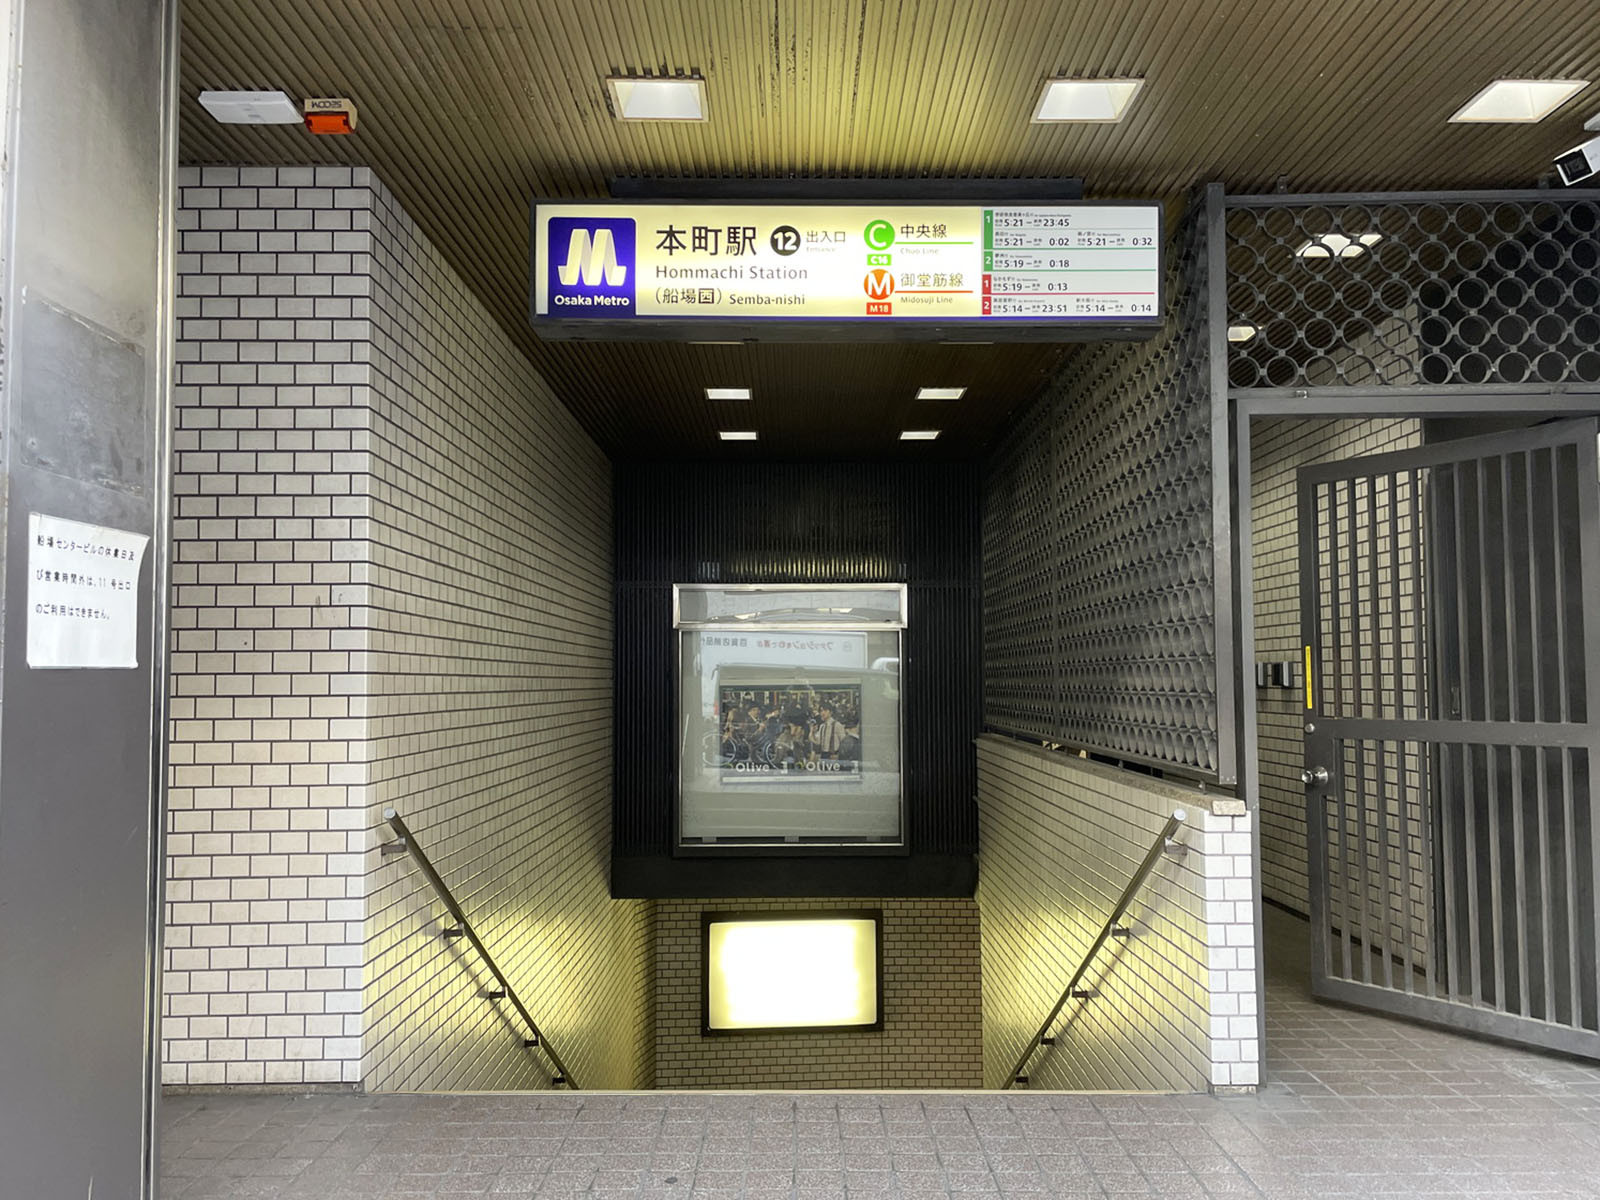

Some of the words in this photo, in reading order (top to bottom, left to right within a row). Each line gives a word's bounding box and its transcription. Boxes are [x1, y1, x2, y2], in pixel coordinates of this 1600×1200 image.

[311, 100, 342, 108] SECOM
[1004, 218, 1024, 227] 5:21
[1043, 218, 1070, 227] 23:45
[806, 230, 846, 243] 出入口
[869, 224, 887, 248] C
[900, 224, 947, 238] 中央線
[655, 224, 757, 256] 本町駅
[773, 231, 798, 251] 12
[1004, 238, 1024, 246] 5:21
[1049, 238, 1070, 246] 0:02
[1087, 238, 1106, 246] 5:21
[1132, 238, 1153, 246] 0:32
[986, 256, 991, 264] 2
[1004, 260, 1024, 268] 5:19
[1049, 260, 1070, 268] 0:18
[655, 266, 744, 280] Hommachi
[749, 266, 808, 280] Station
[868, 273, 891, 296] M
[900, 272, 964, 288] 御堂筋線
[1002, 283, 1022, 291] 5:19
[1048, 283, 1068, 291] 0:13
[554, 294, 592, 306] Osaka
[594, 294, 630, 306] Metro
[729, 293, 806, 305] Semba-nishi
[900, 296, 934, 304] Midosuji
[936, 296, 953, 304] Line
[1002, 304, 1022, 313] 5:14
[1042, 304, 1068, 313] 23:51
[1085, 304, 1106, 312] 5:14
[1131, 304, 1152, 312] 0:14
[735, 762, 770, 773] Olive
[806, 761, 841, 772] Olive
